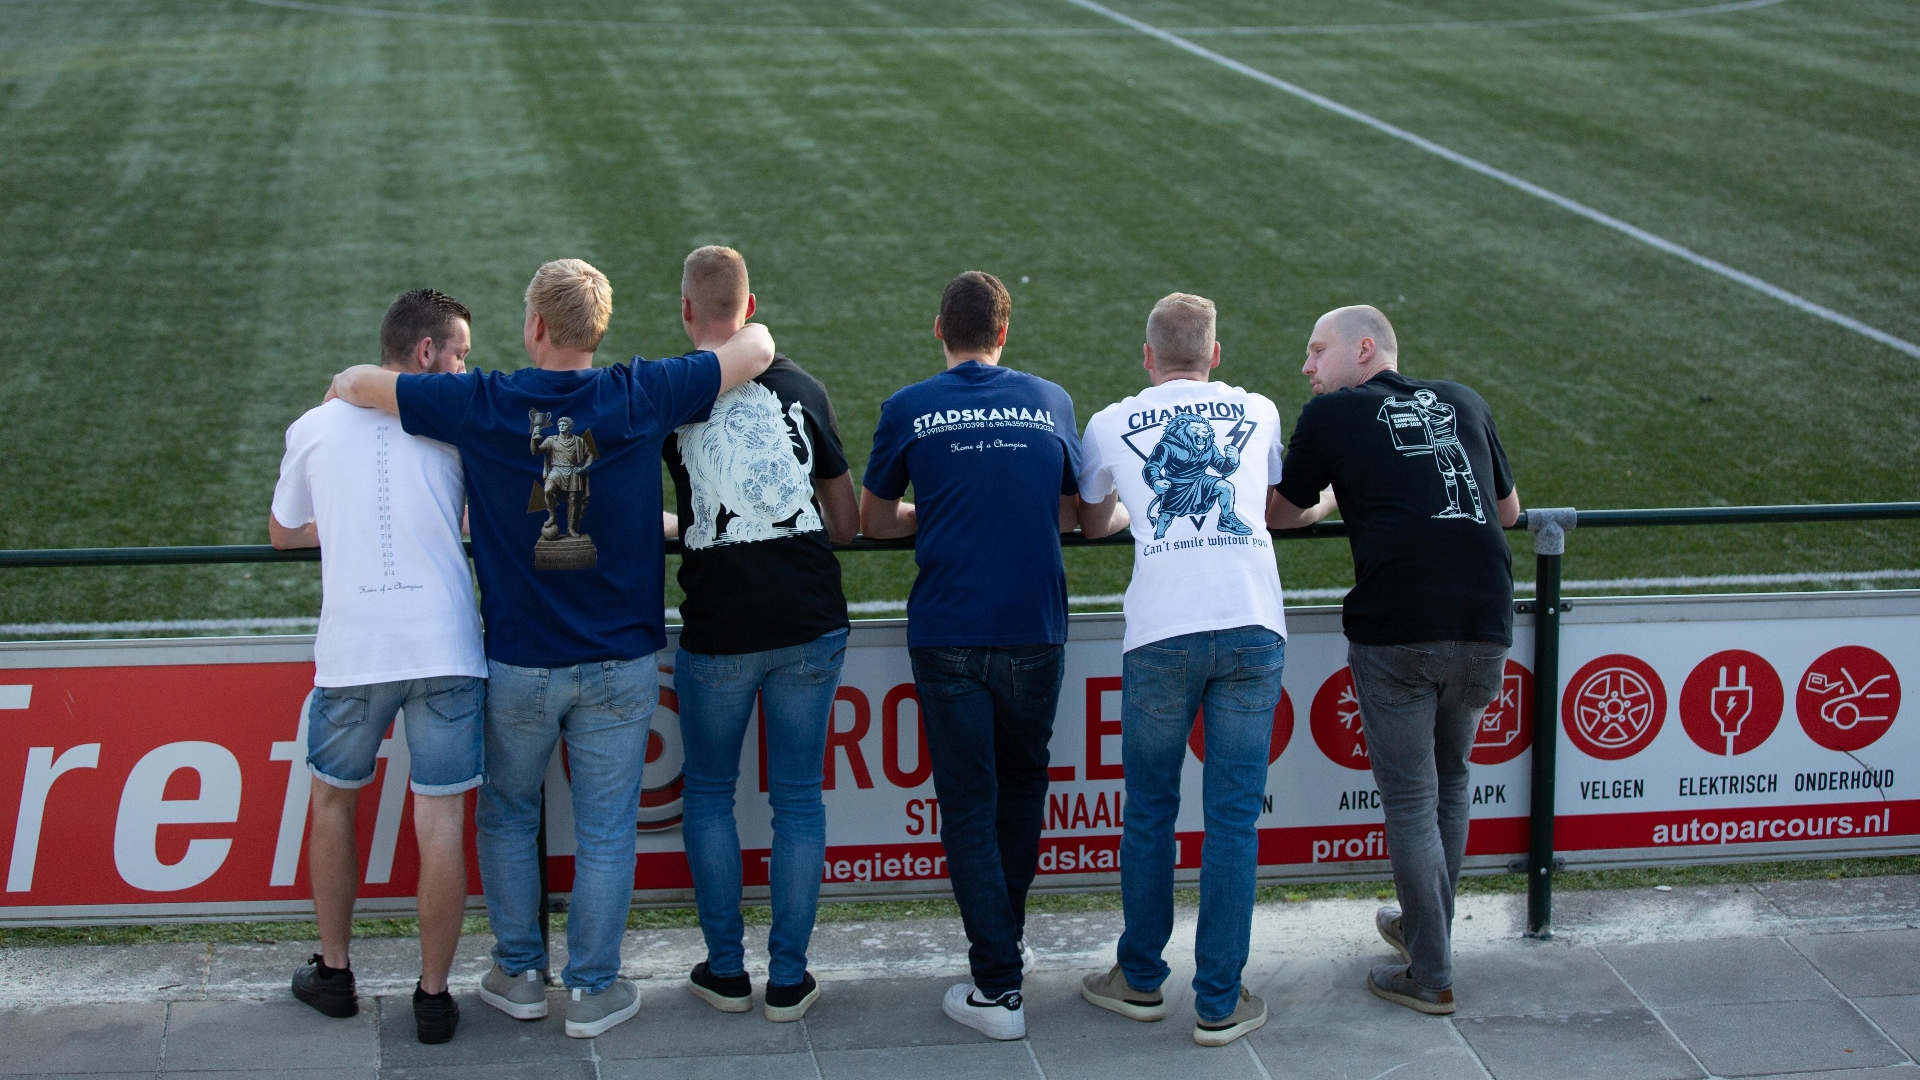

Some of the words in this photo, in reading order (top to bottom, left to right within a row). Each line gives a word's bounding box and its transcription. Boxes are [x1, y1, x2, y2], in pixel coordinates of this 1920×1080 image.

[913, 407, 1055, 433] STADSKANAAL
[1128, 402, 1245, 430] CHAMPION
[950, 442, 974, 453] Home
[976, 440, 984, 452] of
[993, 439, 1028, 451] Champion
[1143, 541, 1170, 556] Can't
[1173, 536, 1204, 550] smile
[1251, 537, 1268, 548] you
[359, 585, 378, 594] Home
[379, 583, 386, 595] of
[393, 581, 424, 592] Champion
[1472, 784, 1506, 805] APK
[1580, 778, 1645, 800] VELGEN
[1679, 773, 1778, 797] ELEKTRISCH
[1794, 769, 1895, 793] ONDERHOUD
[1339, 789, 1381, 811] AIRC
[1652, 808, 1891, 845] autoparcours.nl
[1312, 830, 1389, 863] profi
